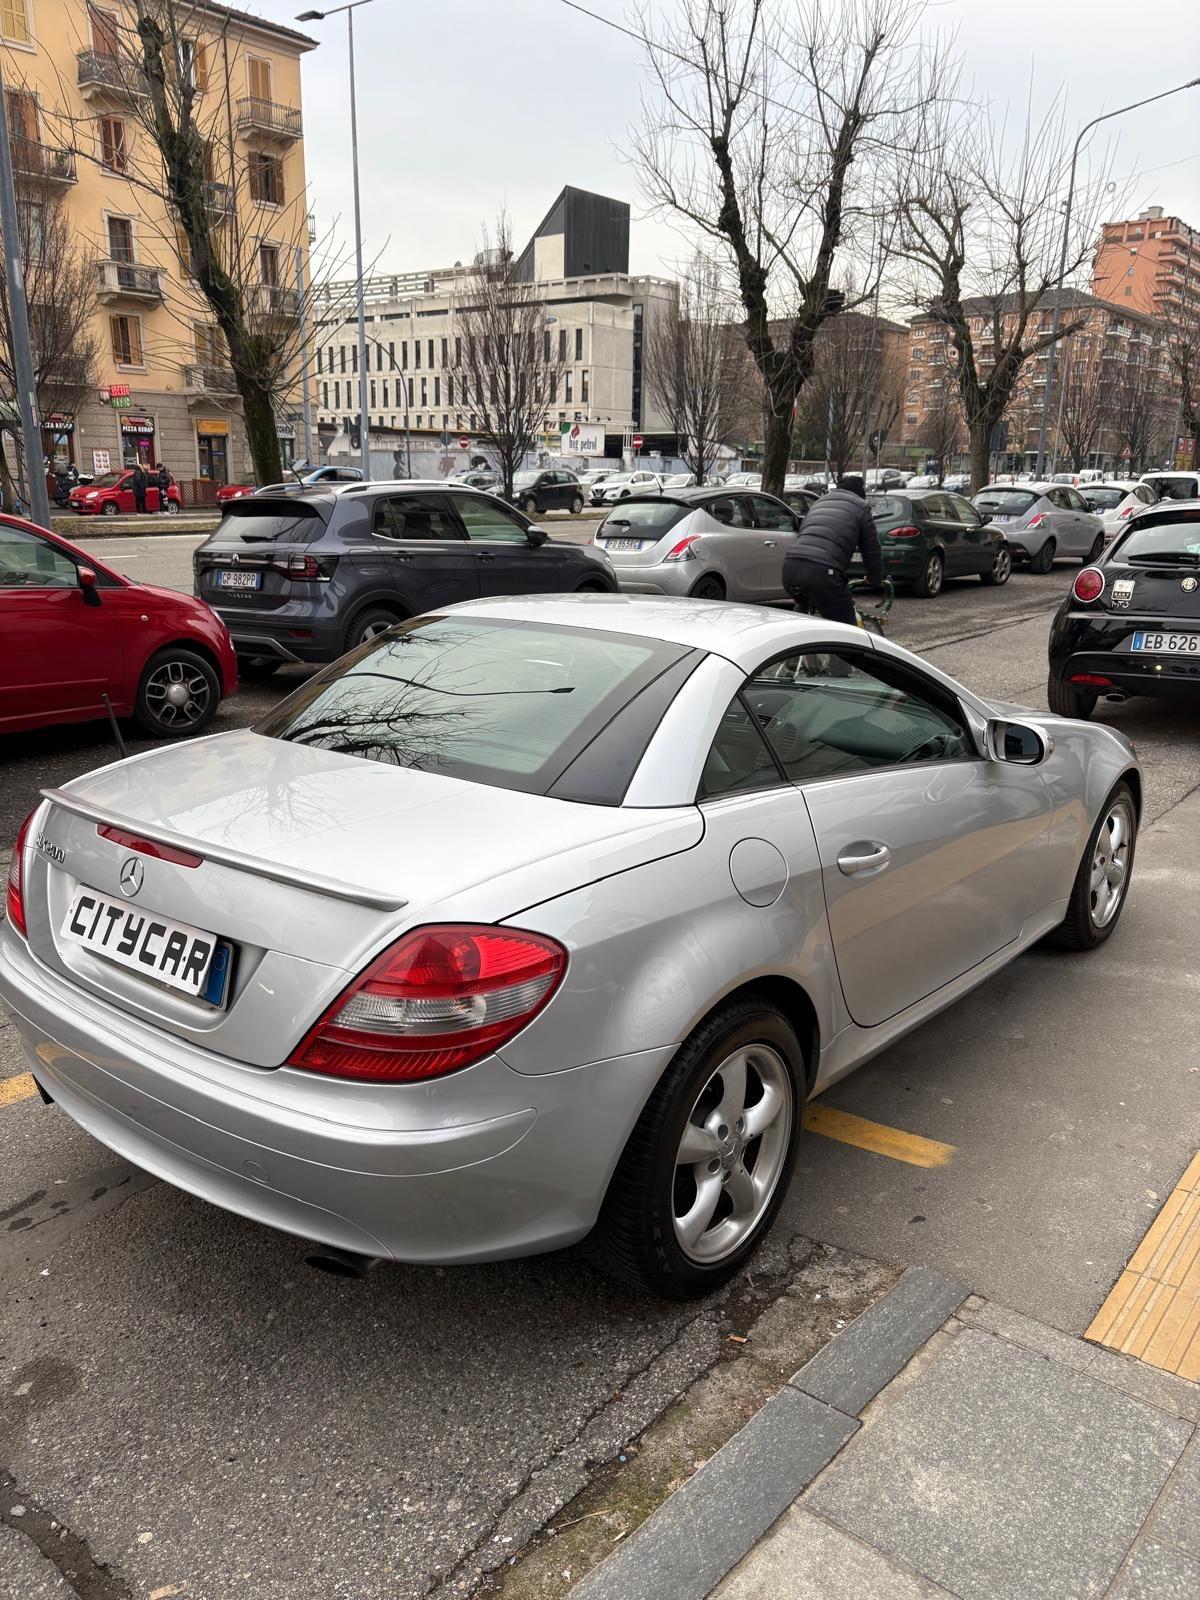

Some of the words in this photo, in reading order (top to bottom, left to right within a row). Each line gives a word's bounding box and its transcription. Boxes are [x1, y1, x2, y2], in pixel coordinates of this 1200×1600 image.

[569, 436, 578, 451] big
[580, 436, 597, 451] petrol
[222, 573, 231, 584] GP
[233, 573, 255, 586] 982PP
[1145, 634, 1163, 649] EB
[1169, 635, 1197, 651] 626
[70, 896, 210, 985] CITYCAR
